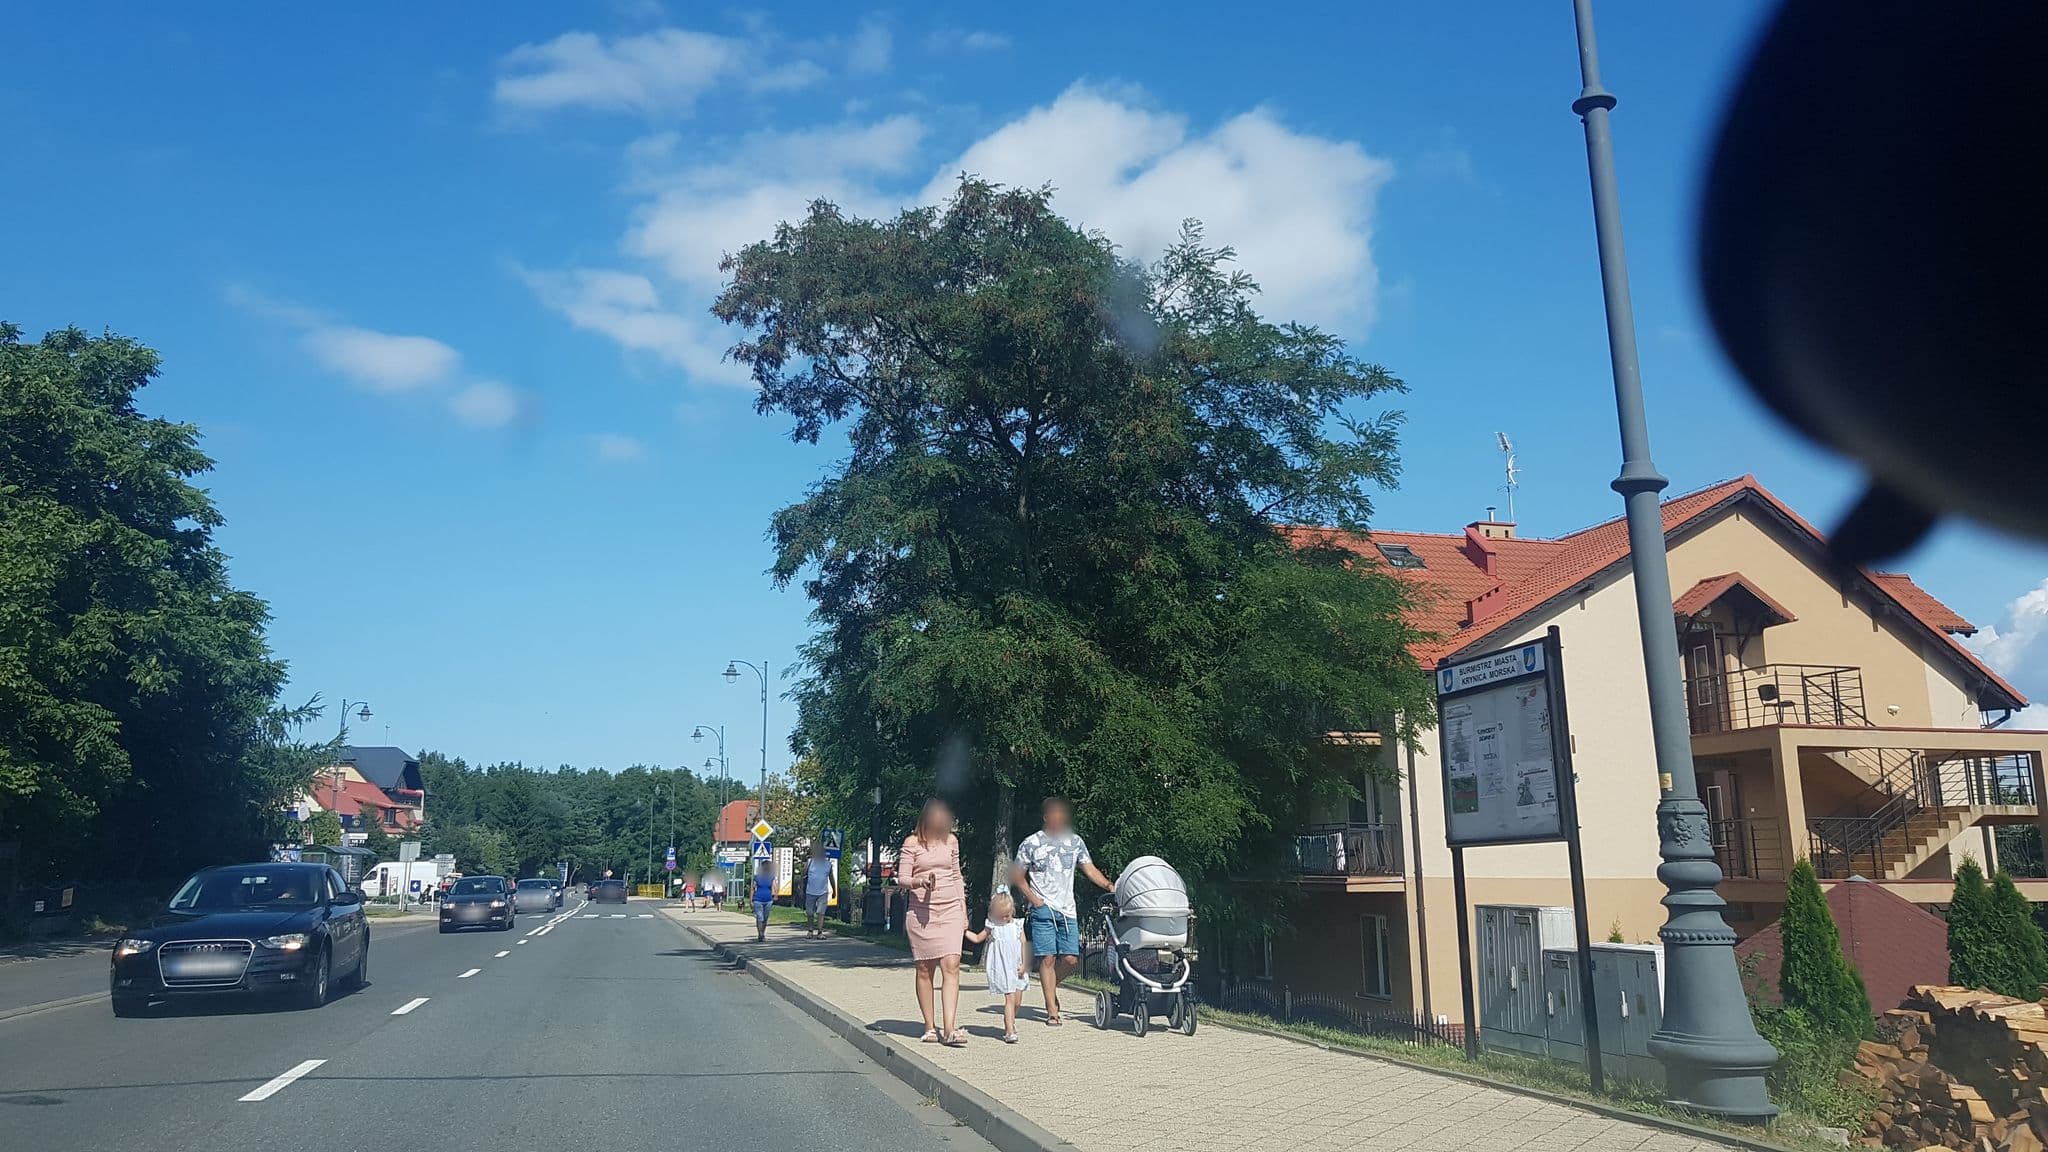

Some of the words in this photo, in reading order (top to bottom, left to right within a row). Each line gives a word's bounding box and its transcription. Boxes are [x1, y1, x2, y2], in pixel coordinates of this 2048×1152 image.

[1459, 661, 1492, 676] BURMISTRZ
[1494, 654, 1518, 666] MIASTA
[1461, 673, 1487, 685] KRYNICA
[1489, 666, 1516, 678] MORSKA
